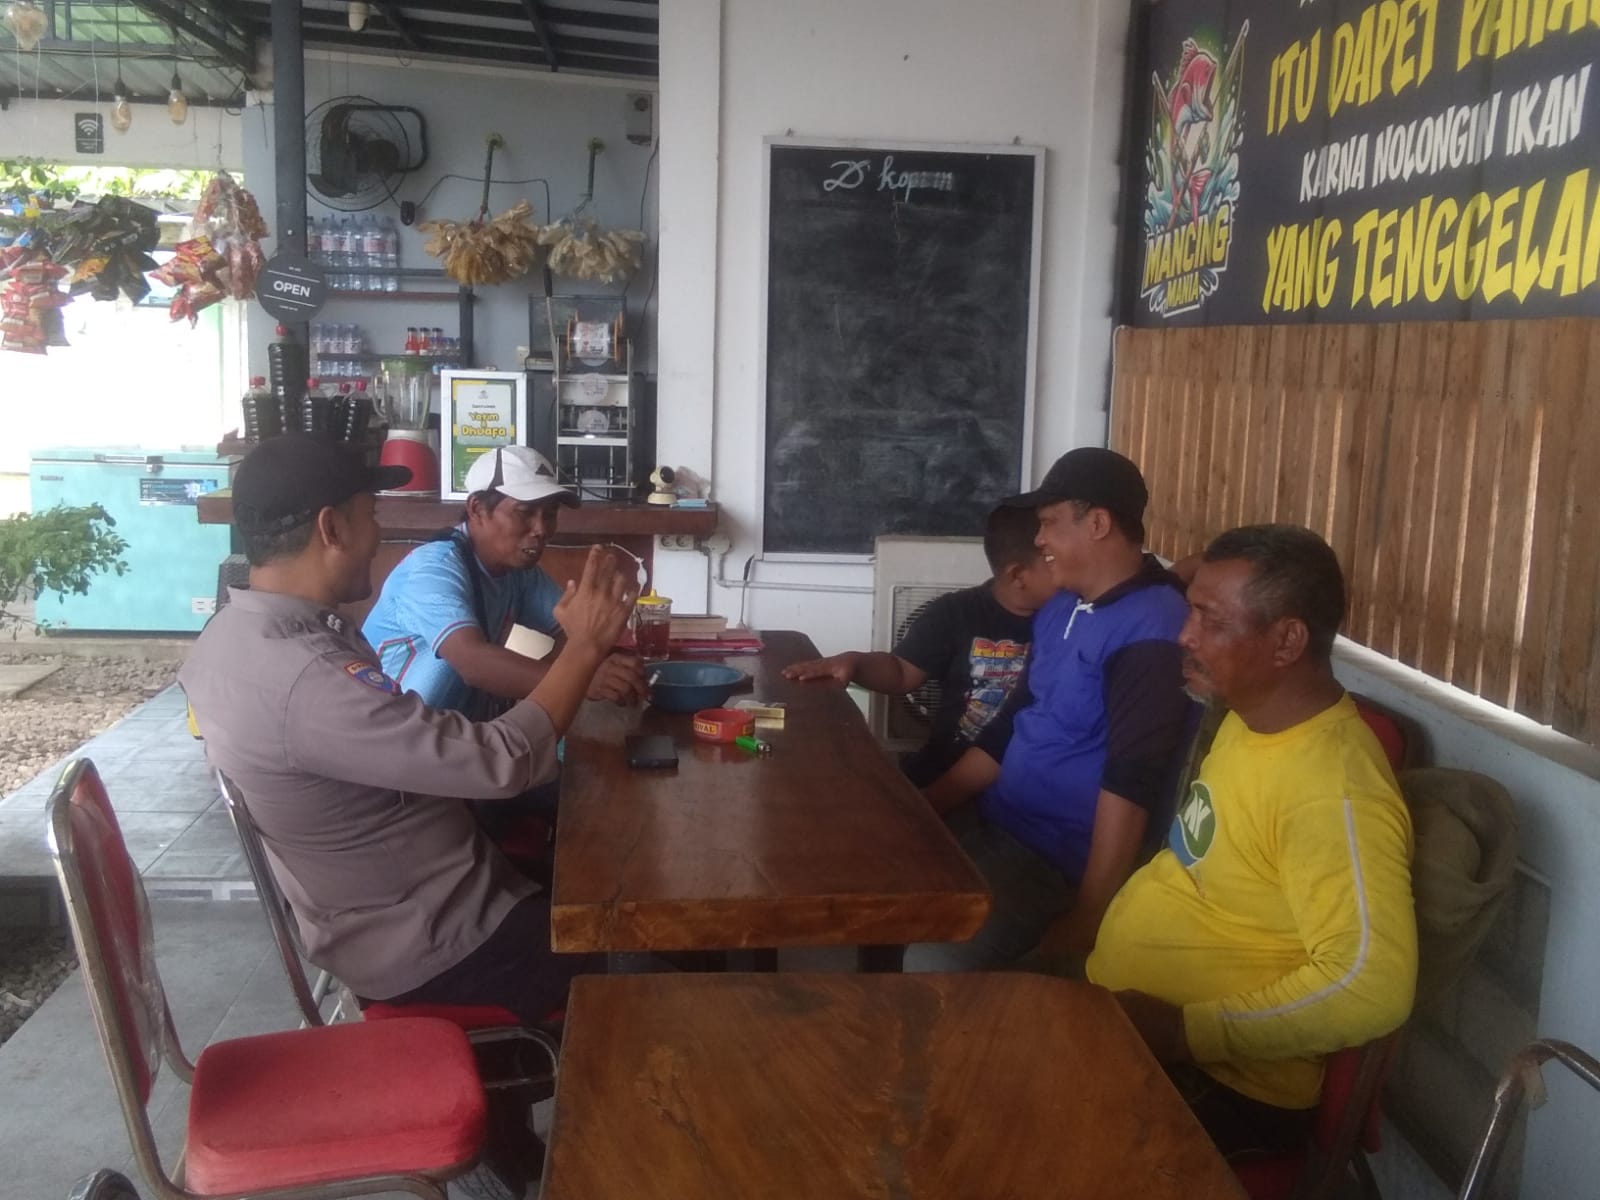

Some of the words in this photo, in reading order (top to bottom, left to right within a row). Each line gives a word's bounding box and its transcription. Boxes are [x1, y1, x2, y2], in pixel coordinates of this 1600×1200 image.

[1267, 27, 1321, 136] ITU
[1328, 0, 1437, 118] DAPET
[1300, 133, 1365, 202] KARNA
[1372, 91, 1502, 188] NOLONGIN
[1506, 64, 1592, 156] IKAN
[1143, 204, 1229, 290] MANCING
[1262, 216, 1341, 314] YANG
[273, 280, 311, 298] OPEN
[1167, 271, 1200, 308] MANIA
[461, 425, 507, 438] Dhuafa
[468, 411, 500, 421] Yatim
